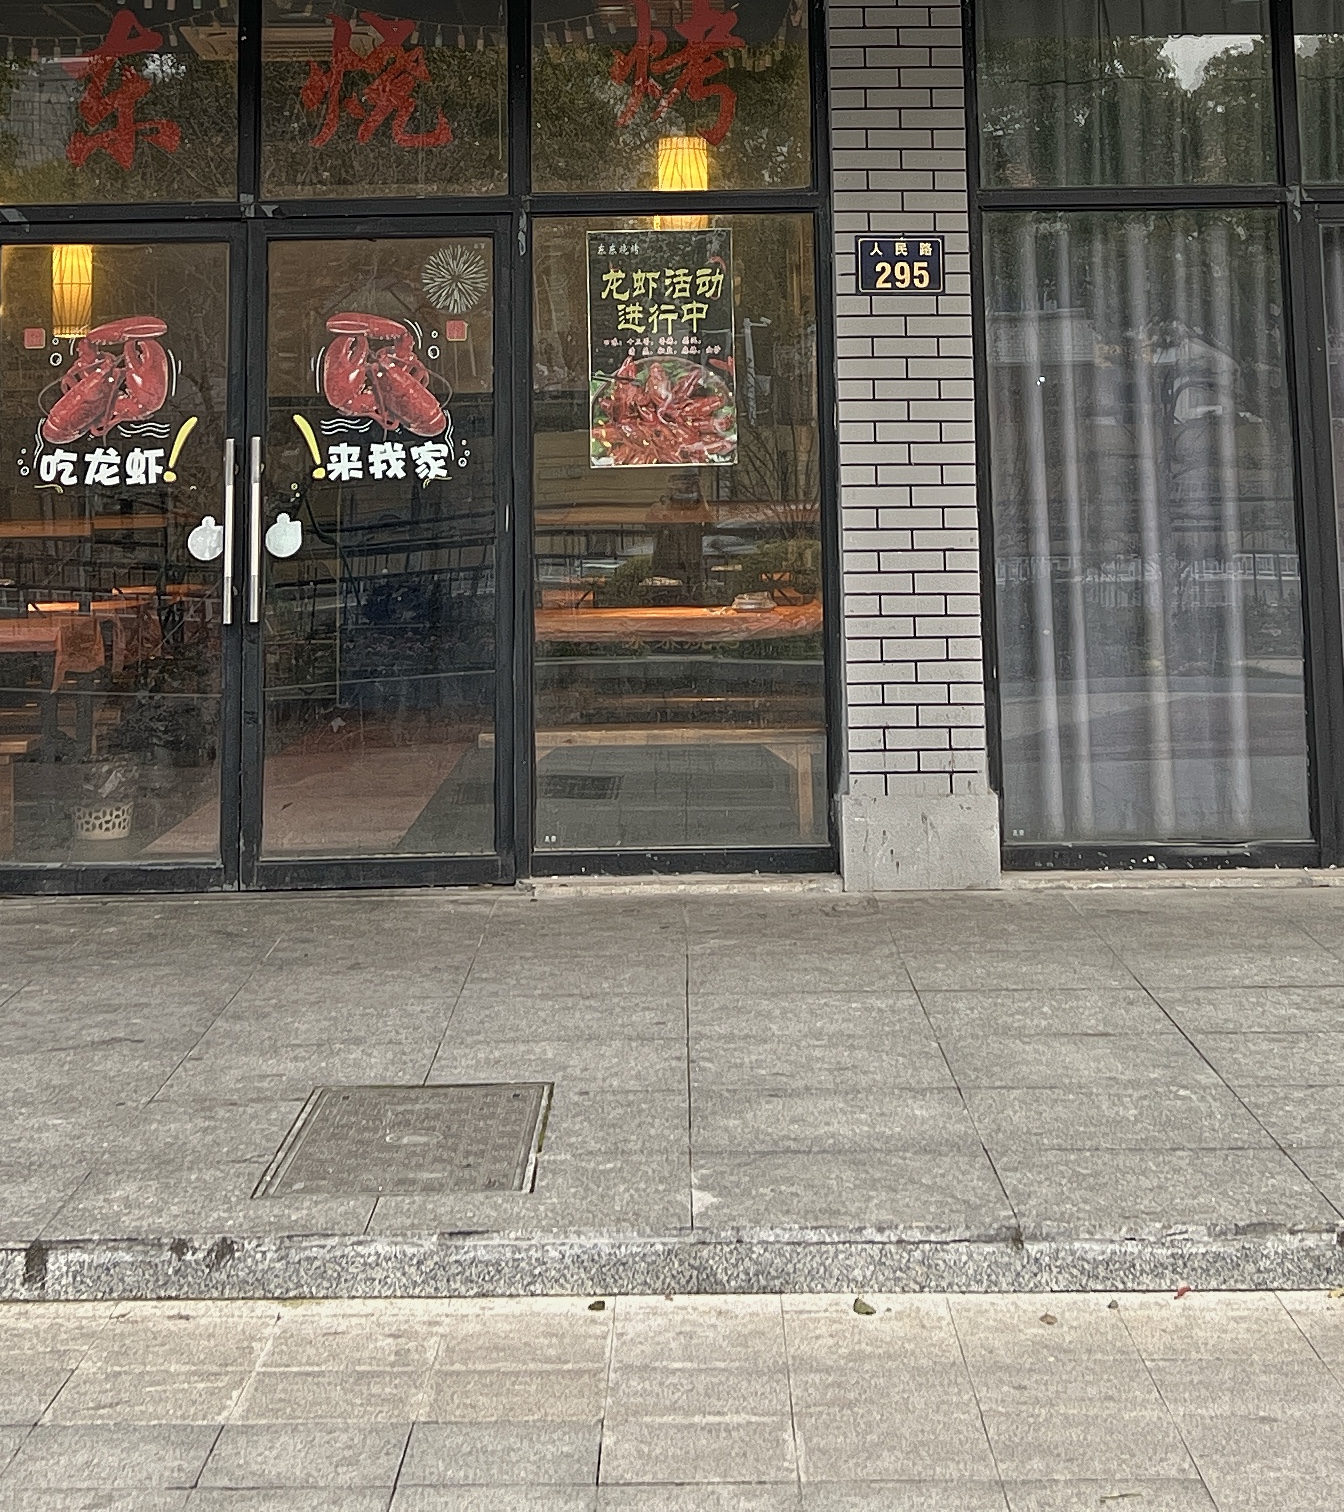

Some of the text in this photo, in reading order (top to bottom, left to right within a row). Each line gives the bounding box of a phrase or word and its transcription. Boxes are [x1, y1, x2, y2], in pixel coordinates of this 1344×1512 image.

[869, 241, 933, 257] 人民路
[601, 268, 725, 301] 龙虾活动
[875, 261, 930, 289] 295
[617, 301, 709, 335] 进行中
